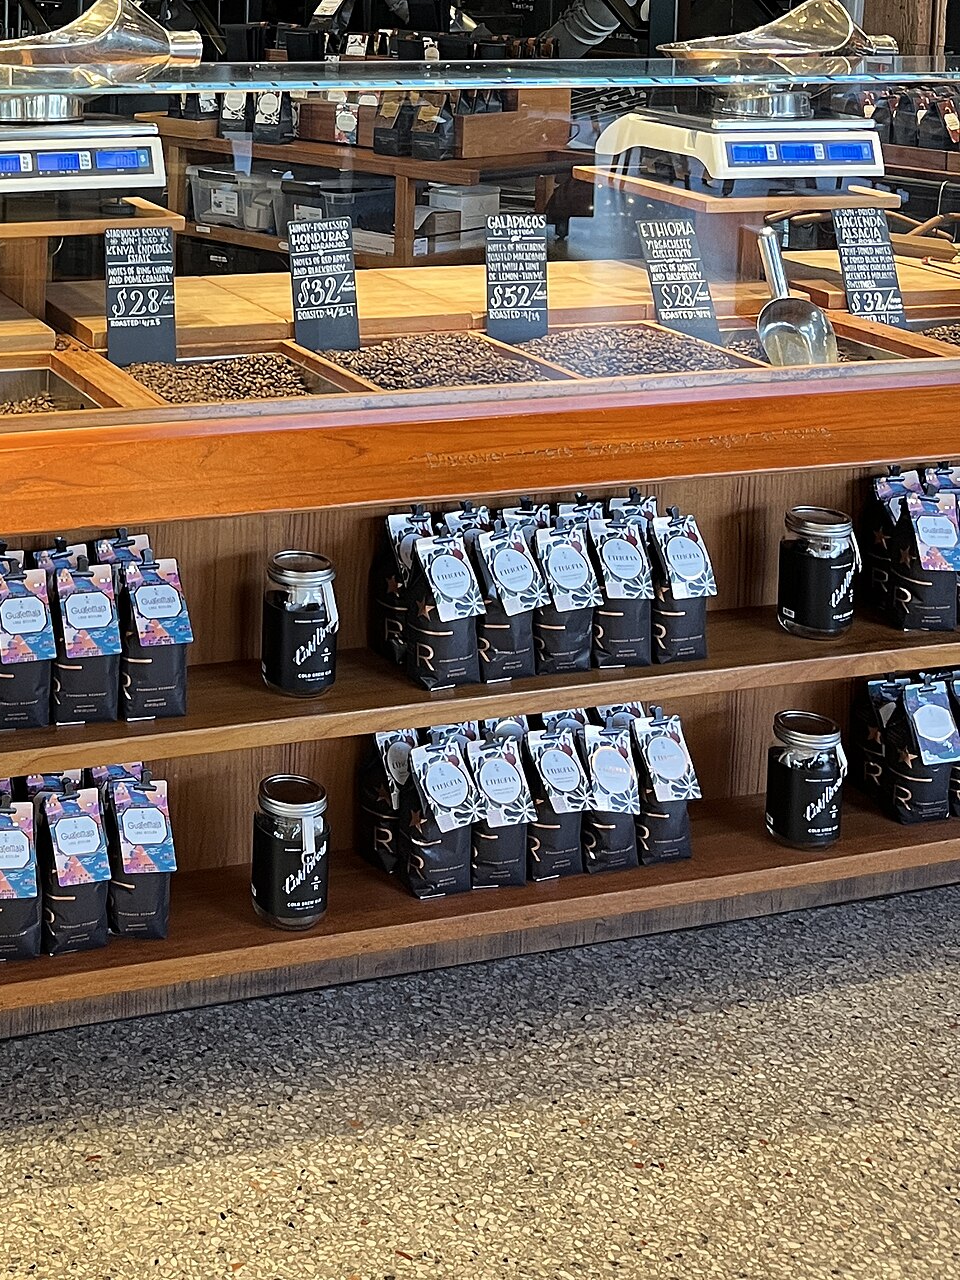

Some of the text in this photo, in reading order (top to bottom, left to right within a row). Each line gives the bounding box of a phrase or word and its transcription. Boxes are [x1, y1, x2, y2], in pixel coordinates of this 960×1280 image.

[488, 215, 546, 229] GALAPAGOS
[835, 216, 885, 228] HACIENDA
[640, 222, 695, 237] ETHIOPIA
[842, 227, 882, 240] ALSACIA
[292, 230, 349, 245] HONDURAS
[107, 245, 135, 255] KENYA
[311, 240, 346, 250] NARANJOS
[293, 258, 312, 266] NOTES
[321, 256, 332, 264] RED
[333, 254, 350, 263] APPLE
[108, 267, 126, 276] NOTES
[293, 264, 346, 276] AND BLACKBERRY
[327, 307, 353, 319] 4/24
